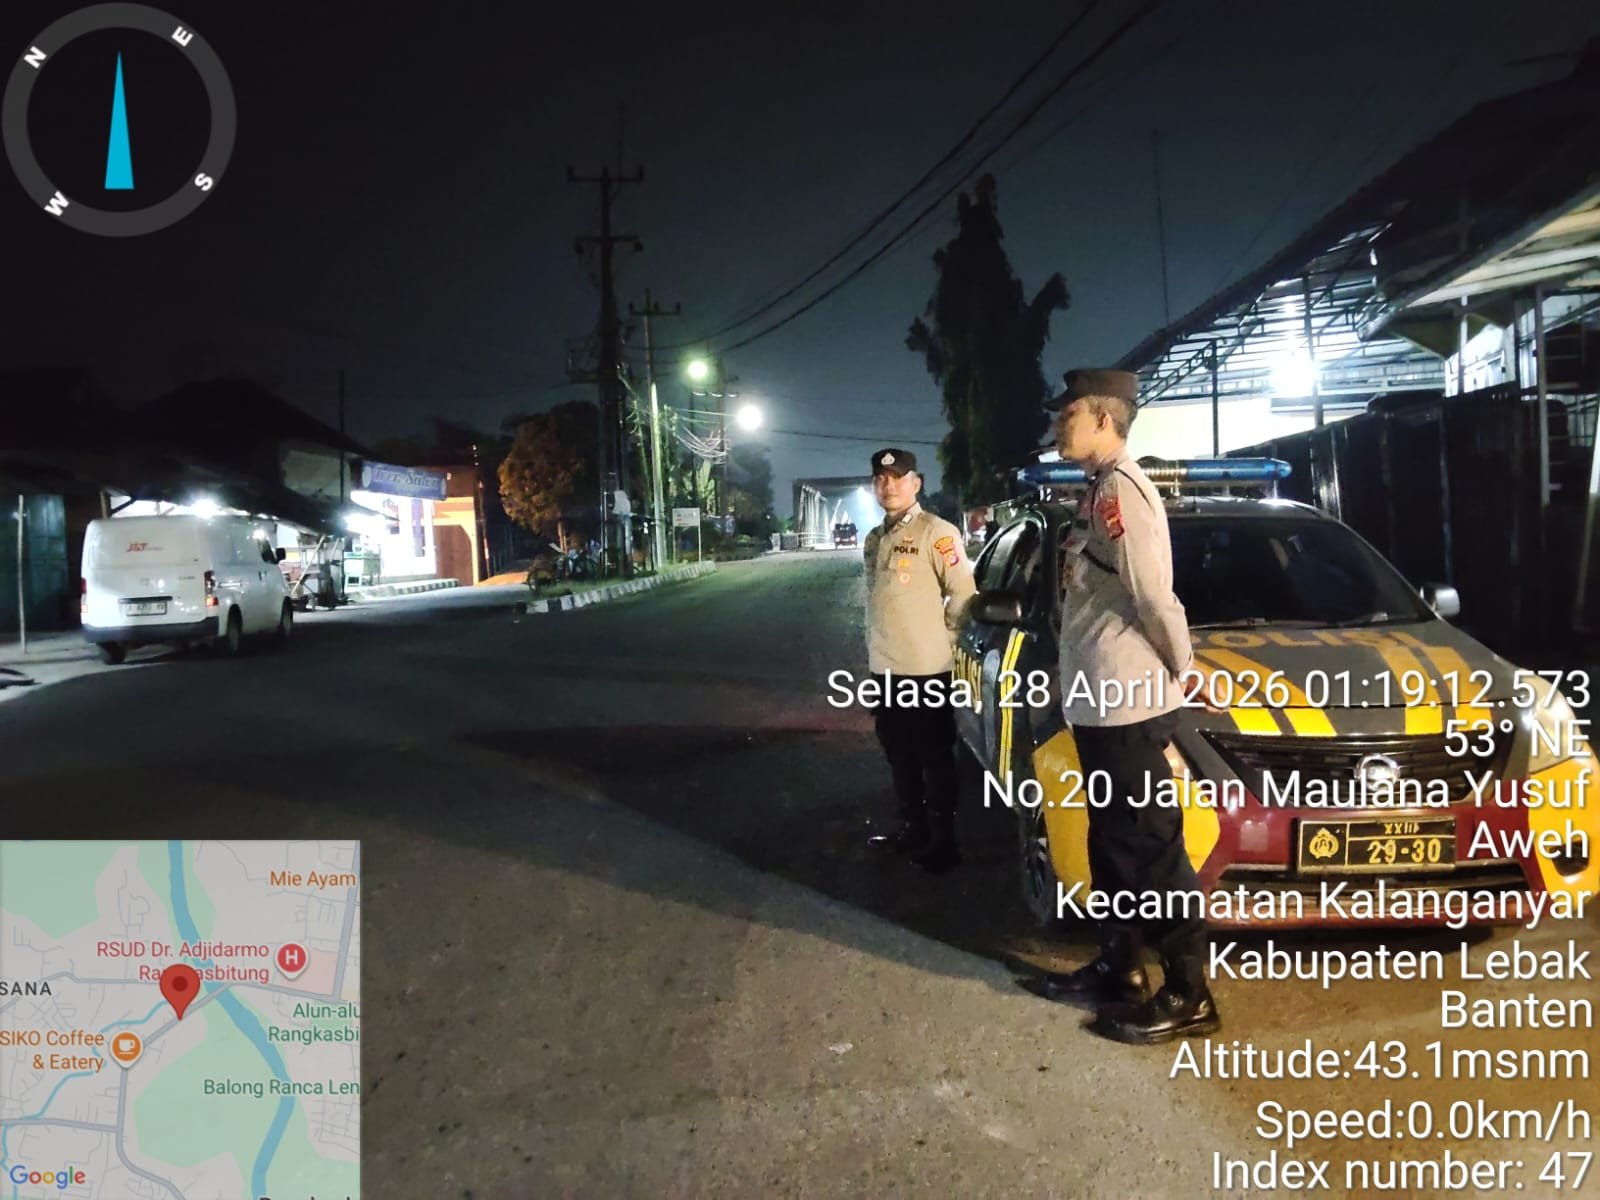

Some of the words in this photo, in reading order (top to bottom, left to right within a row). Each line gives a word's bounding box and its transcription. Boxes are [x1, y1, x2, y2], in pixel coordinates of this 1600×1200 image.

[893, 545, 919, 556] POLRI
[1189, 631, 1429, 650] OLISI
[1368, 838, 1441, 864] 29-30
